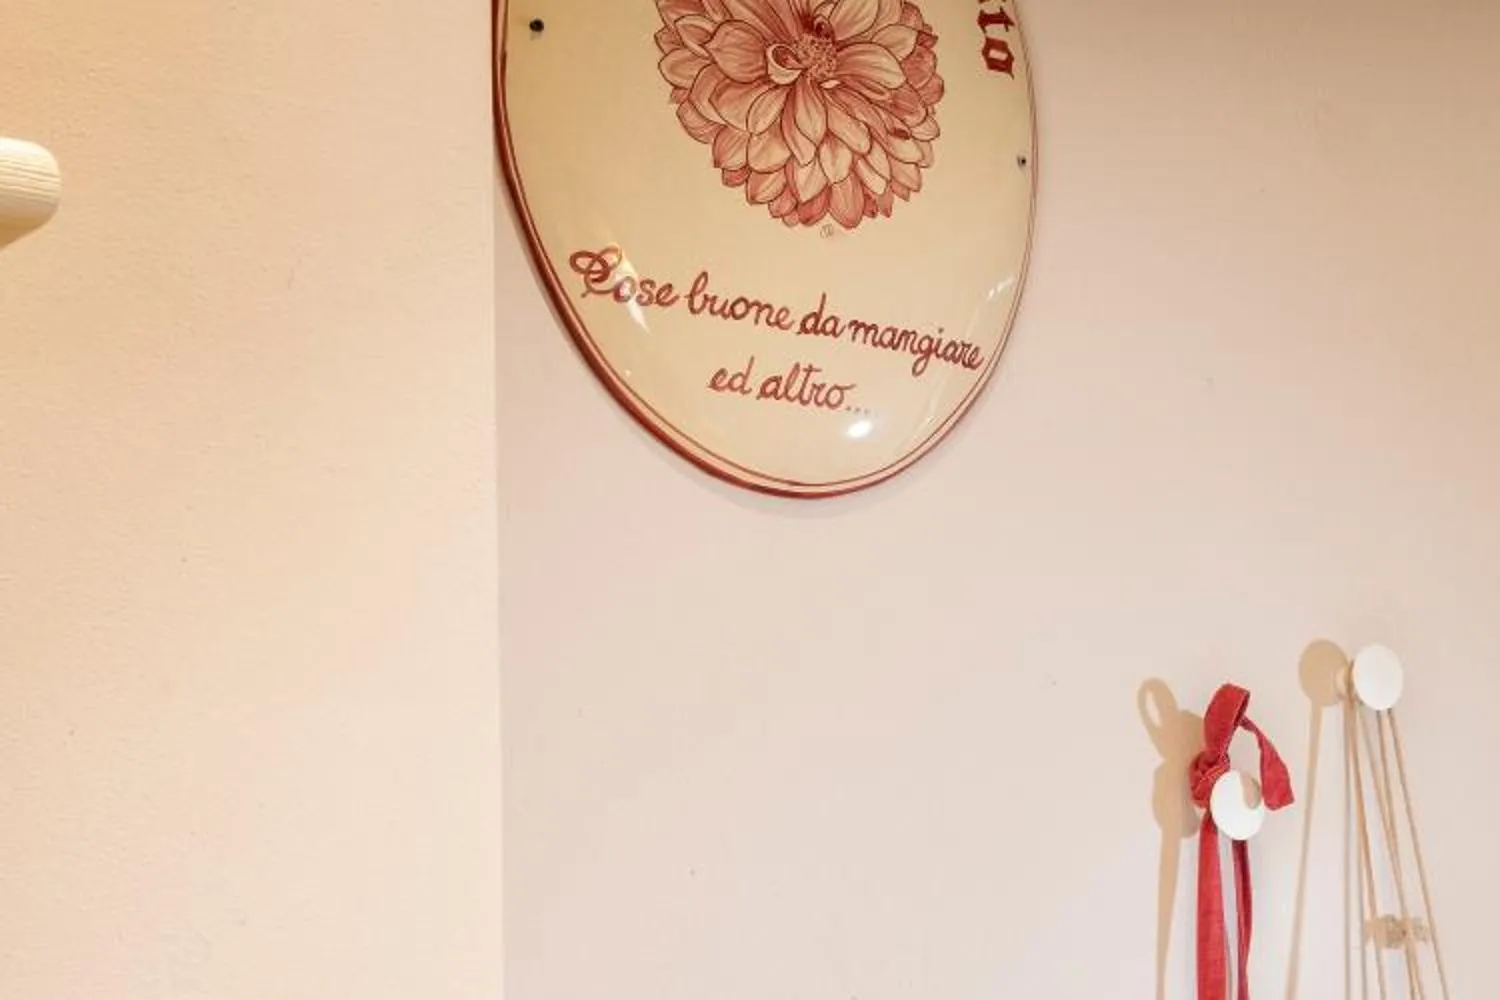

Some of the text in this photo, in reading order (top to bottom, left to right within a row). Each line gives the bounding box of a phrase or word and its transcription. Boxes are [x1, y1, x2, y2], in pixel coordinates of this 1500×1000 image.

[976, 0, 1015, 80] to
[569, 246, 985, 378] Cose buone da mangiare
[707, 356, 752, 395] ed
